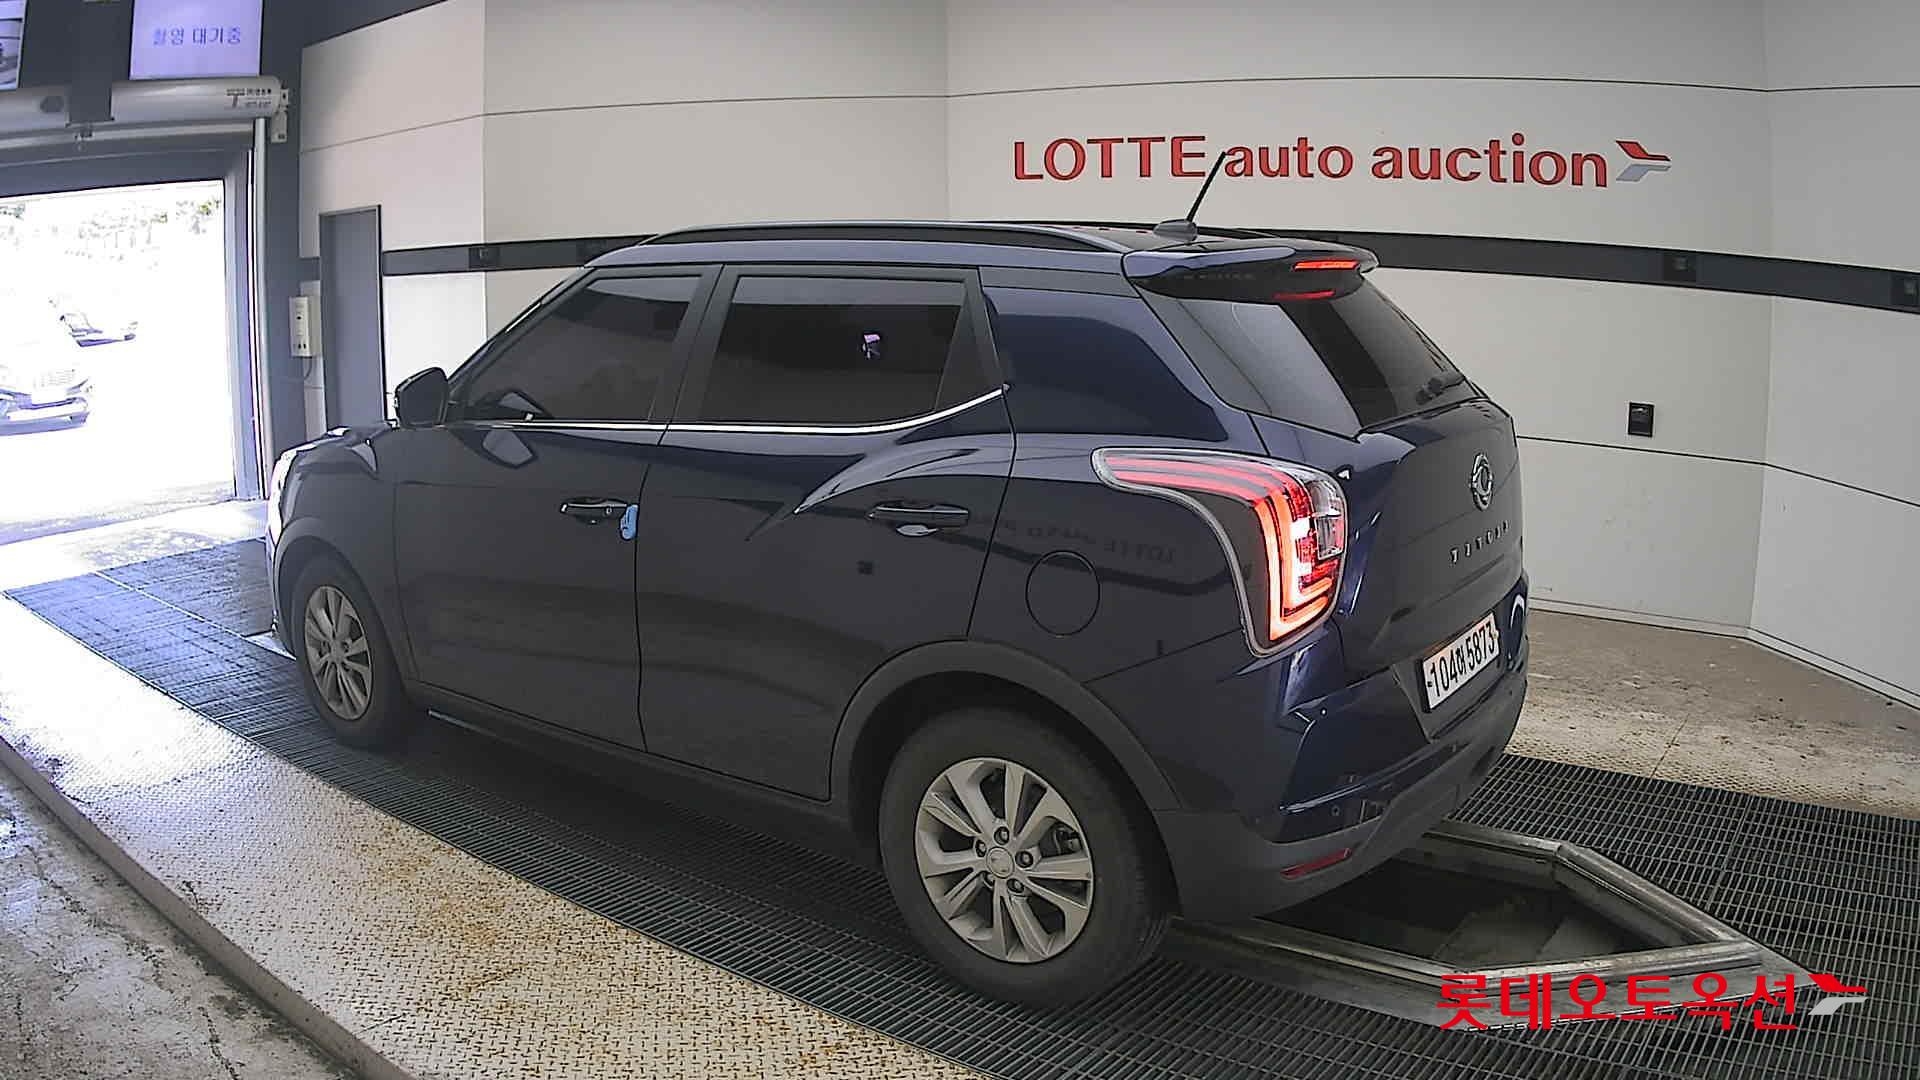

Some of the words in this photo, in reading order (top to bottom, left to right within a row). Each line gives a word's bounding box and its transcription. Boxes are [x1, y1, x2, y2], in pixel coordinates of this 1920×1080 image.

[1014, 136, 1206, 180] LOTTE
[1224, 136, 1354, 179] auto
[1371, 132, 1608, 188] auction
